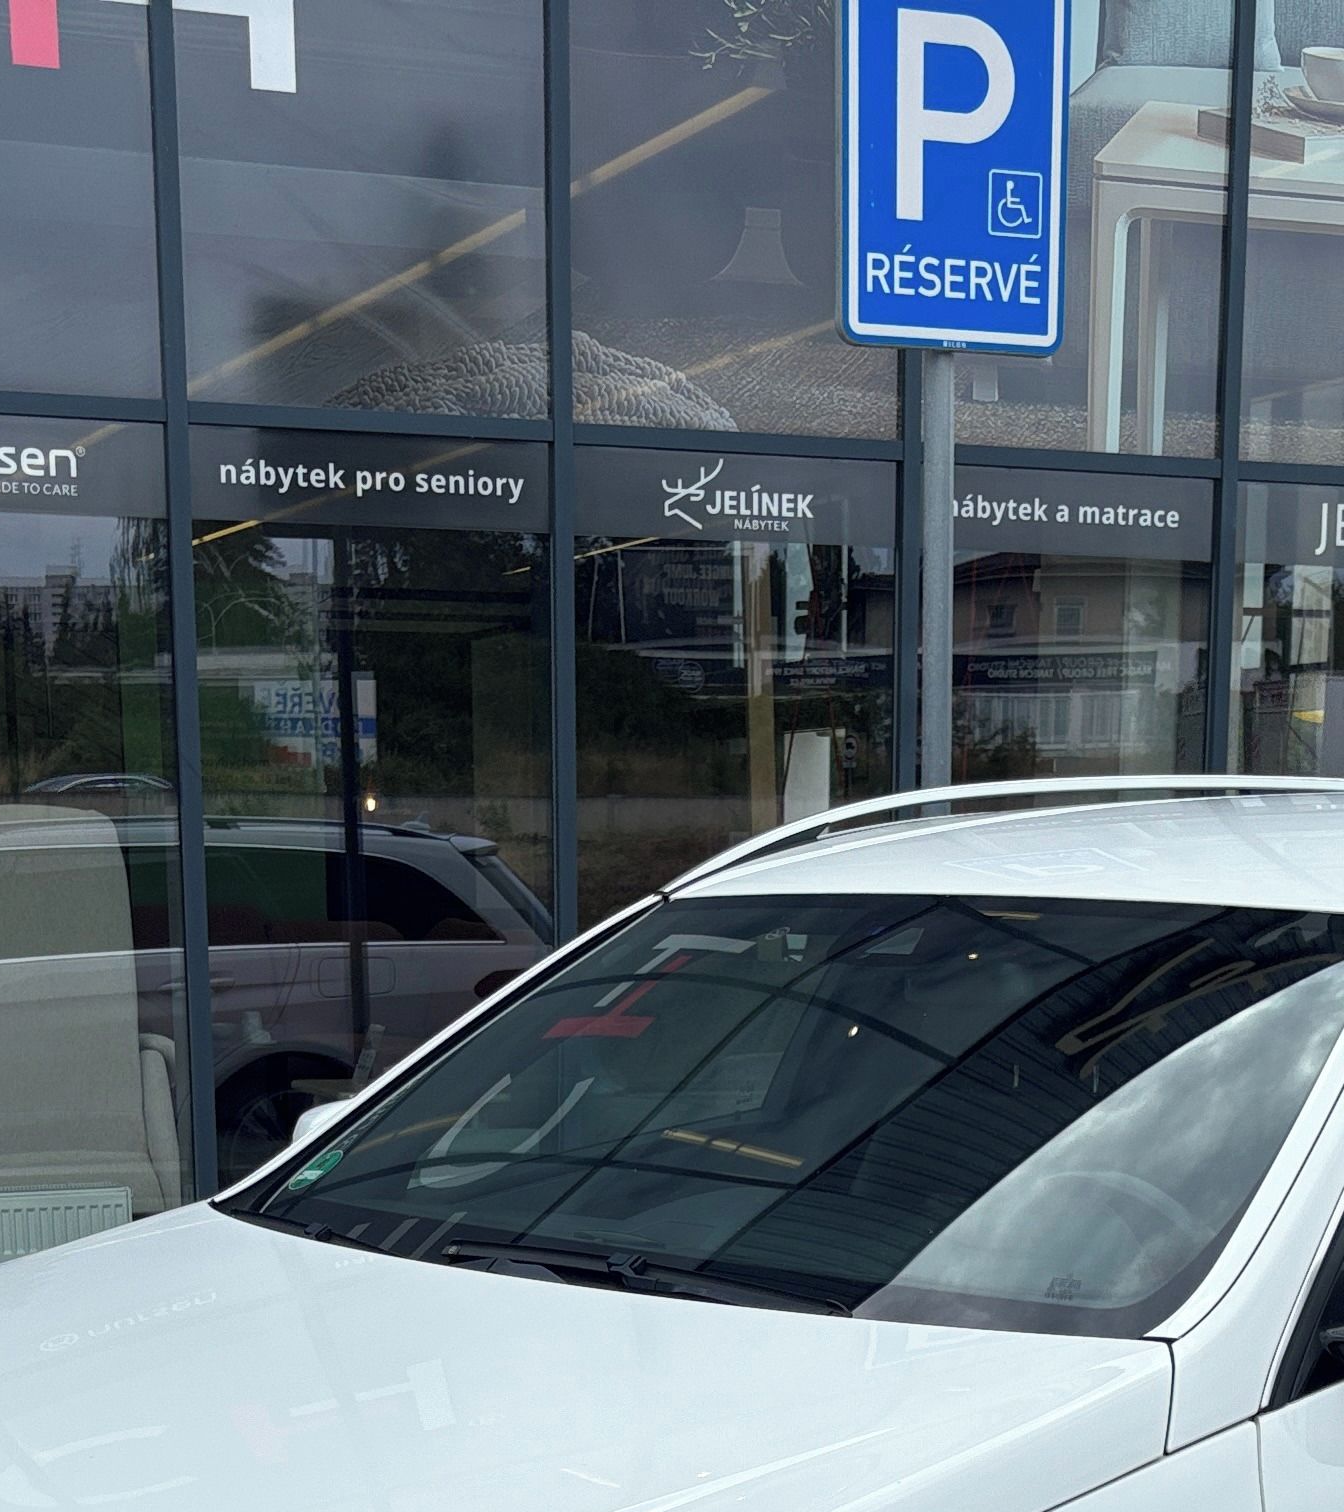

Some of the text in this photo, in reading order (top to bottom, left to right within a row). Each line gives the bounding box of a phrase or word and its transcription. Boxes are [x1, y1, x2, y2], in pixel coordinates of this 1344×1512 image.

[896, 8, 1016, 221] P
[866, 244, 1042, 305] RÉSERVÉ
[22, 482, 41, 496] TO
[43, 483, 79, 497] CARE
[219, 458, 525, 504] nábytek pro seniory
[706, 484, 815, 519] JELÍNEK
[1056, 504, 1070, 522] a
[1078, 504, 1181, 528] matrace
[734, 517, 790, 532] NÁBYTEK
